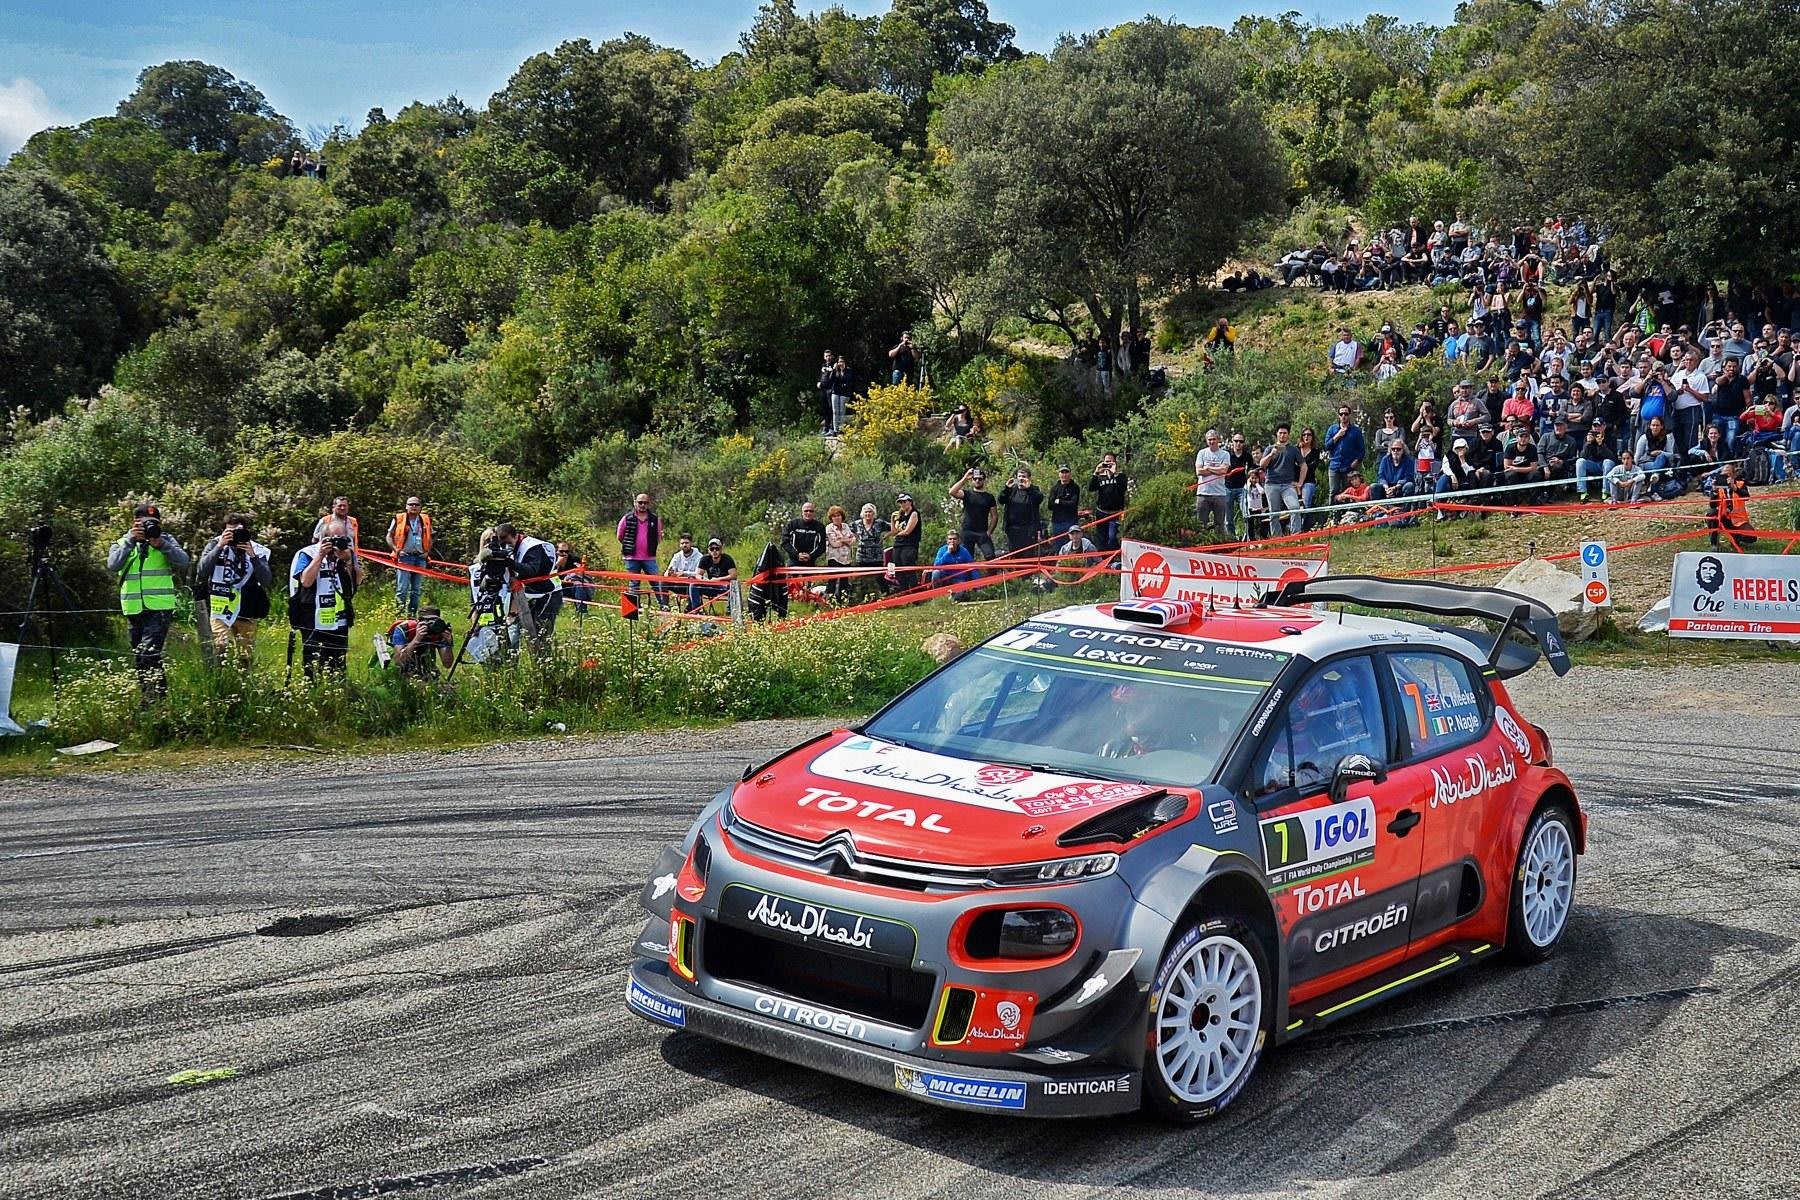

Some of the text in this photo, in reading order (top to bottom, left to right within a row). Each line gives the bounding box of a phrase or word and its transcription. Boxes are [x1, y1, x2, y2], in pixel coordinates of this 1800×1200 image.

[1189, 559, 1259, 578] PUBLIC
[1591, 571, 1598, 579] 8
[1587, 588, 1604, 598] CSP
[1693, 594, 1725, 612] Che
[1686, 621, 1772, 633] Partenaire Titre
[1073, 644, 1158, 666] Lexar
[1215, 646, 1275, 660] CERTINA
[1183, 659, 1218, 670] Lexar
[1451, 690, 1477, 708] Meeke
[1456, 712, 1479, 732] Nagle
[796, 786, 953, 834] TOTAL
[1022, 797, 1066, 809] TOUR
[1071, 794, 1090, 803] DE
[1031, 806, 1052, 815] 2017
[1213, 818, 1238, 830] WRC
[1314, 808, 1370, 851] IGOL
[1311, 864, 1323, 874] Rally
[1323, 855, 1353, 871] Championship
[1293, 876, 1366, 915] TOTAL
[1158, 930, 1197, 987] MICHELIN
[631, 987, 684, 1020] MICHELIN
[929, 1078, 1023, 1101] MICHELIN
[1044, 1080, 1116, 1096] IDENTICAR
